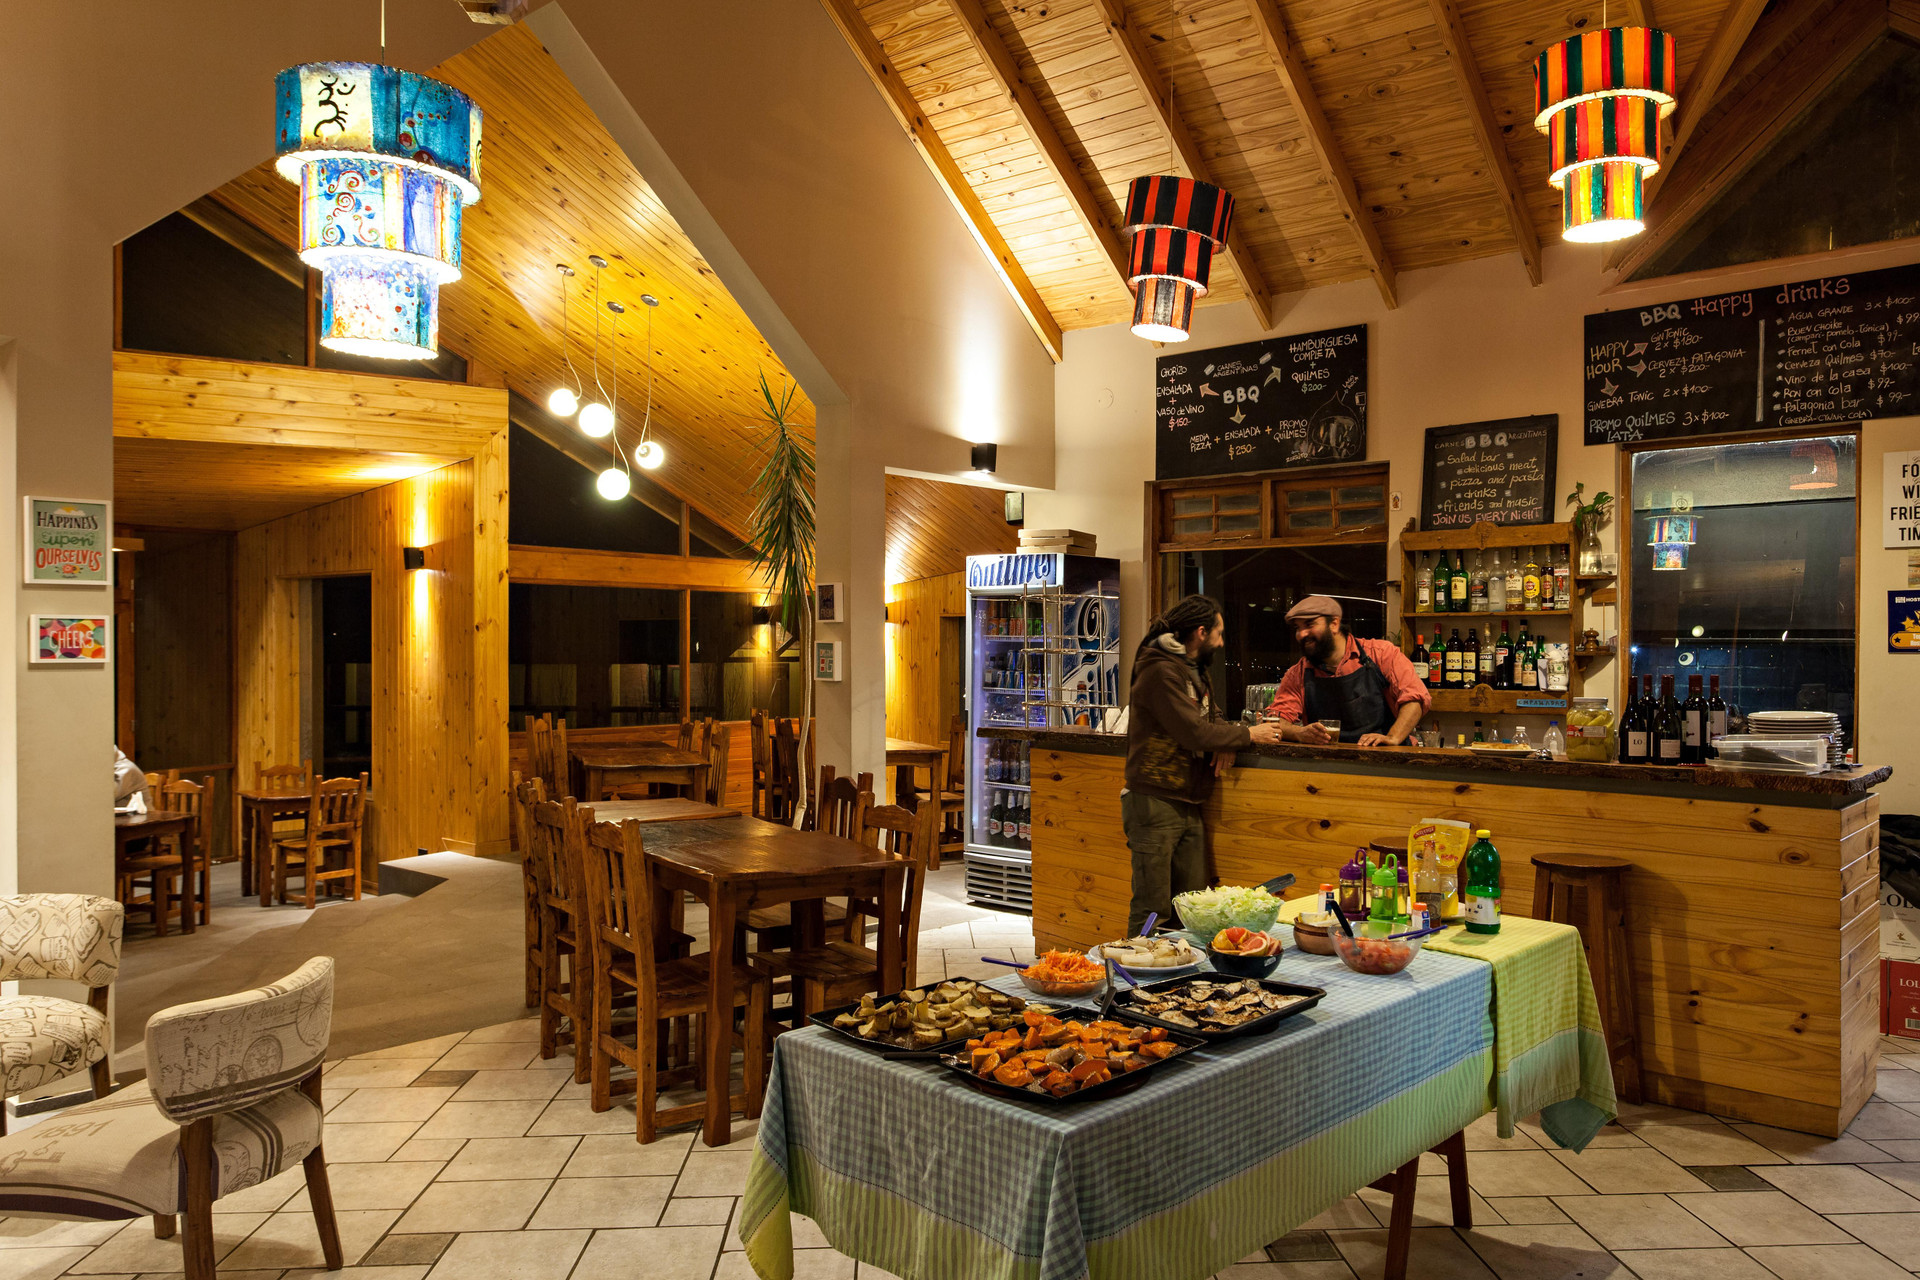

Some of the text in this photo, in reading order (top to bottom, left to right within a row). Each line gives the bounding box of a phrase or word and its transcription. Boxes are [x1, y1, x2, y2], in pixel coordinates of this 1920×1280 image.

[1640, 278, 1850, 327] BBQ Happy drinks
[1788, 311, 1814, 322] AGUA
[1818, 305, 1854, 318] GRANDE
[1787, 324, 1813, 337] BUEN
[1289, 334, 1358, 354] HAMBURGUESA
[1590, 340, 1630, 362] HAPPY
[1822, 344, 1838, 352] con
[1294, 348, 1337, 363] COMPLETA
[1784, 360, 1820, 370] Cerveza
[1825, 352, 1865, 367] Quilmes
[1586, 358, 1623, 380] HOUR
[1648, 356, 1688, 371] CERVEZA
[1812, 372, 1824, 383] de
[1830, 369, 1838, 381] la
[1842, 367, 1872, 378] casa
[1156, 384, 1193, 398] ENSALADA
[1222, 385, 1260, 404] BBQ
[1806, 389, 1822, 398] con
[1841, 397, 1864, 410] bar
[1156, 406, 1176, 417] VASO
[1279, 419, 1308, 430] PROMO
[1589, 419, 1622, 433] PROMO
[1224, 426, 1260, 441] ENSALADA
[1465, 432, 1509, 449] BBQ
[1508, 430, 1548, 440] ARGENTINAS
[1607, 429, 1644, 442] LATA
[1448, 451, 1500, 464] Salad bar
[1464, 462, 1504, 474] delicious
[1488, 474, 1508, 484] and
[1510, 468, 1544, 488] pasta
[1464, 488, 1497, 498] drinks
[1444, 496, 1538, 513] friends and music
[37, 512, 98, 530] HAPPINESS
[1458, 513, 1472, 524] US
[1476, 510, 1508, 522] EVERY
[42, 532, 94, 548] upon
[36, 548, 102, 572] OURSELVES
[50, 630, 94, 650] CHEERS
